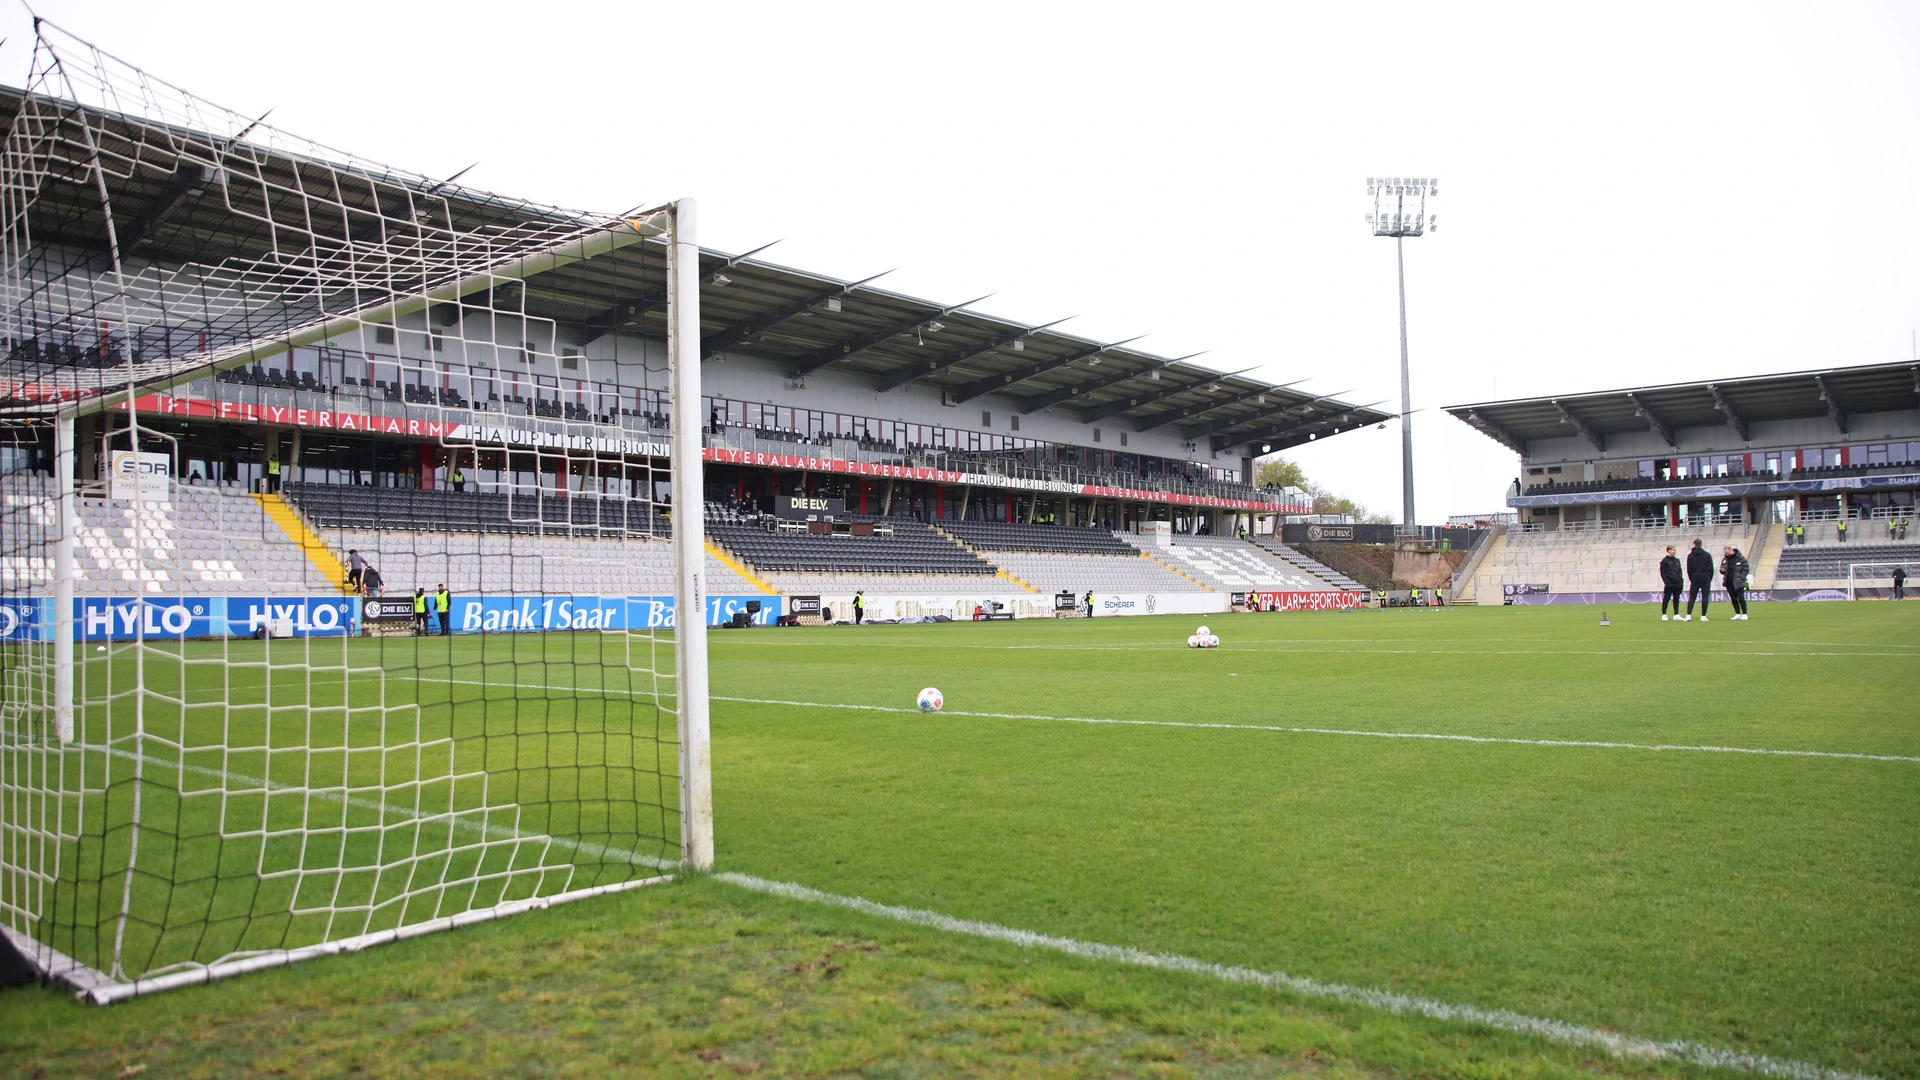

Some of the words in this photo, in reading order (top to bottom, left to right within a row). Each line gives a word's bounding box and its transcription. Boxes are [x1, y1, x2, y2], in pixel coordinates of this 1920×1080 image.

[221, 402, 442, 436] FLYERALARM
[848, 461, 956, 482] FLYERALARM
[791, 497, 808, 509] DIE
[1095, 485, 1168, 501] FLYERALARM
[1189, 497, 1249, 509] FLYERALARM
[382, 605, 395, 613] DIE
[1104, 600, 1135, 609] SCHERER
